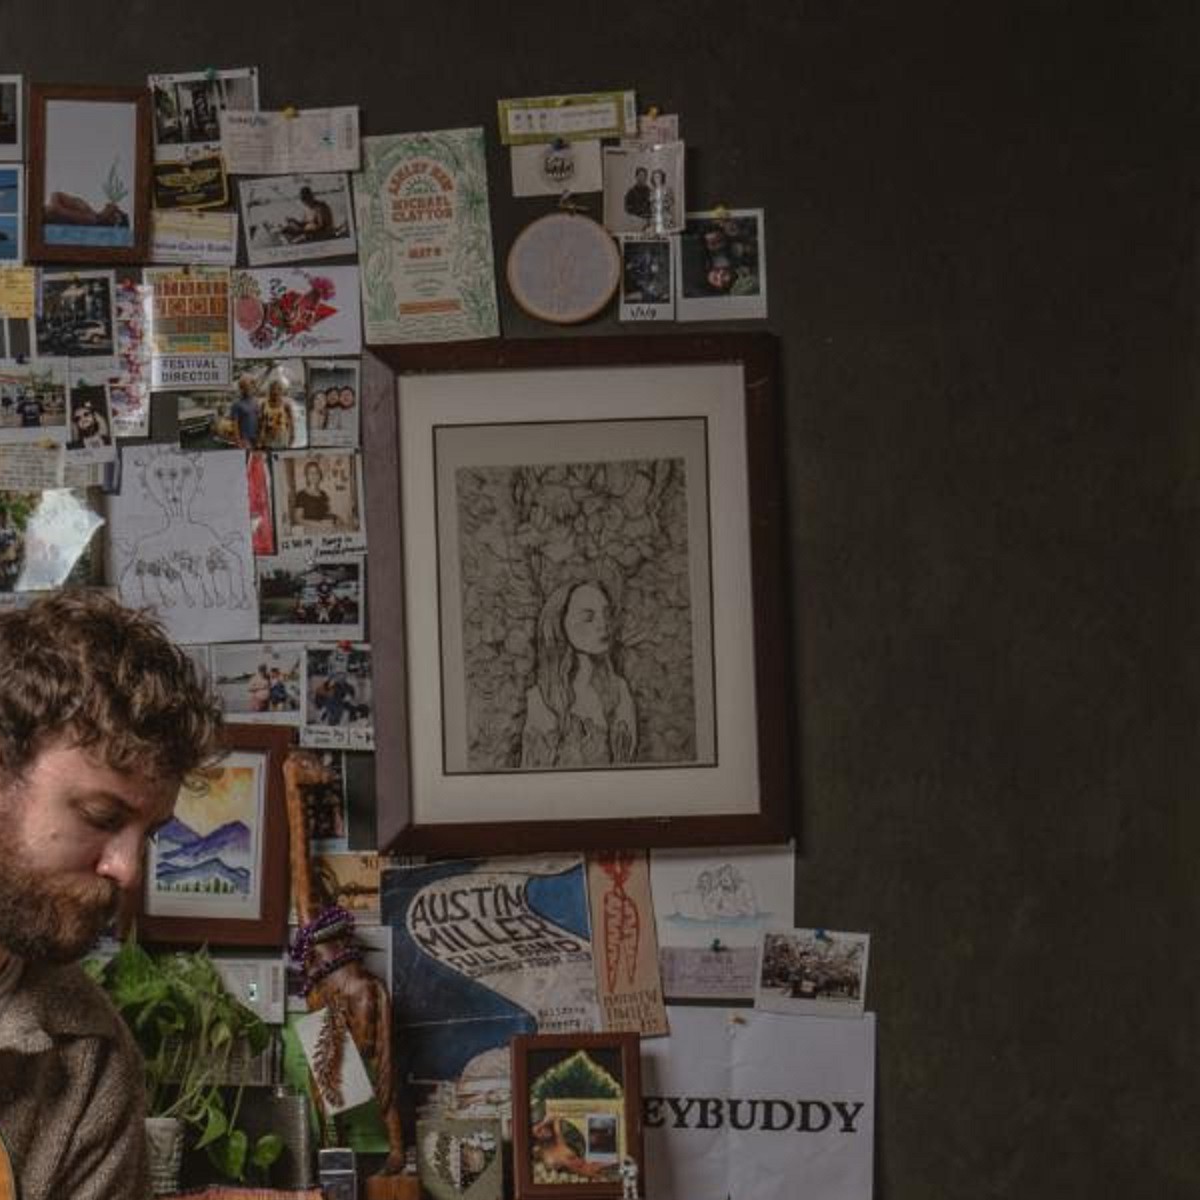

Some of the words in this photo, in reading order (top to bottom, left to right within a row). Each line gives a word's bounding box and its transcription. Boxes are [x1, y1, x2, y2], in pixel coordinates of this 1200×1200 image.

[161, 371, 219, 382] DIRECTOR
[162, 357, 219, 369] FESTIVAL
[411, 884, 529, 930] AUSTIN
[416, 916, 564, 956] MILLER
[447, 949, 505, 969] FULL
[514, 938, 580, 959] BAND
[641, 1096, 865, 1133] EYBUDDY
